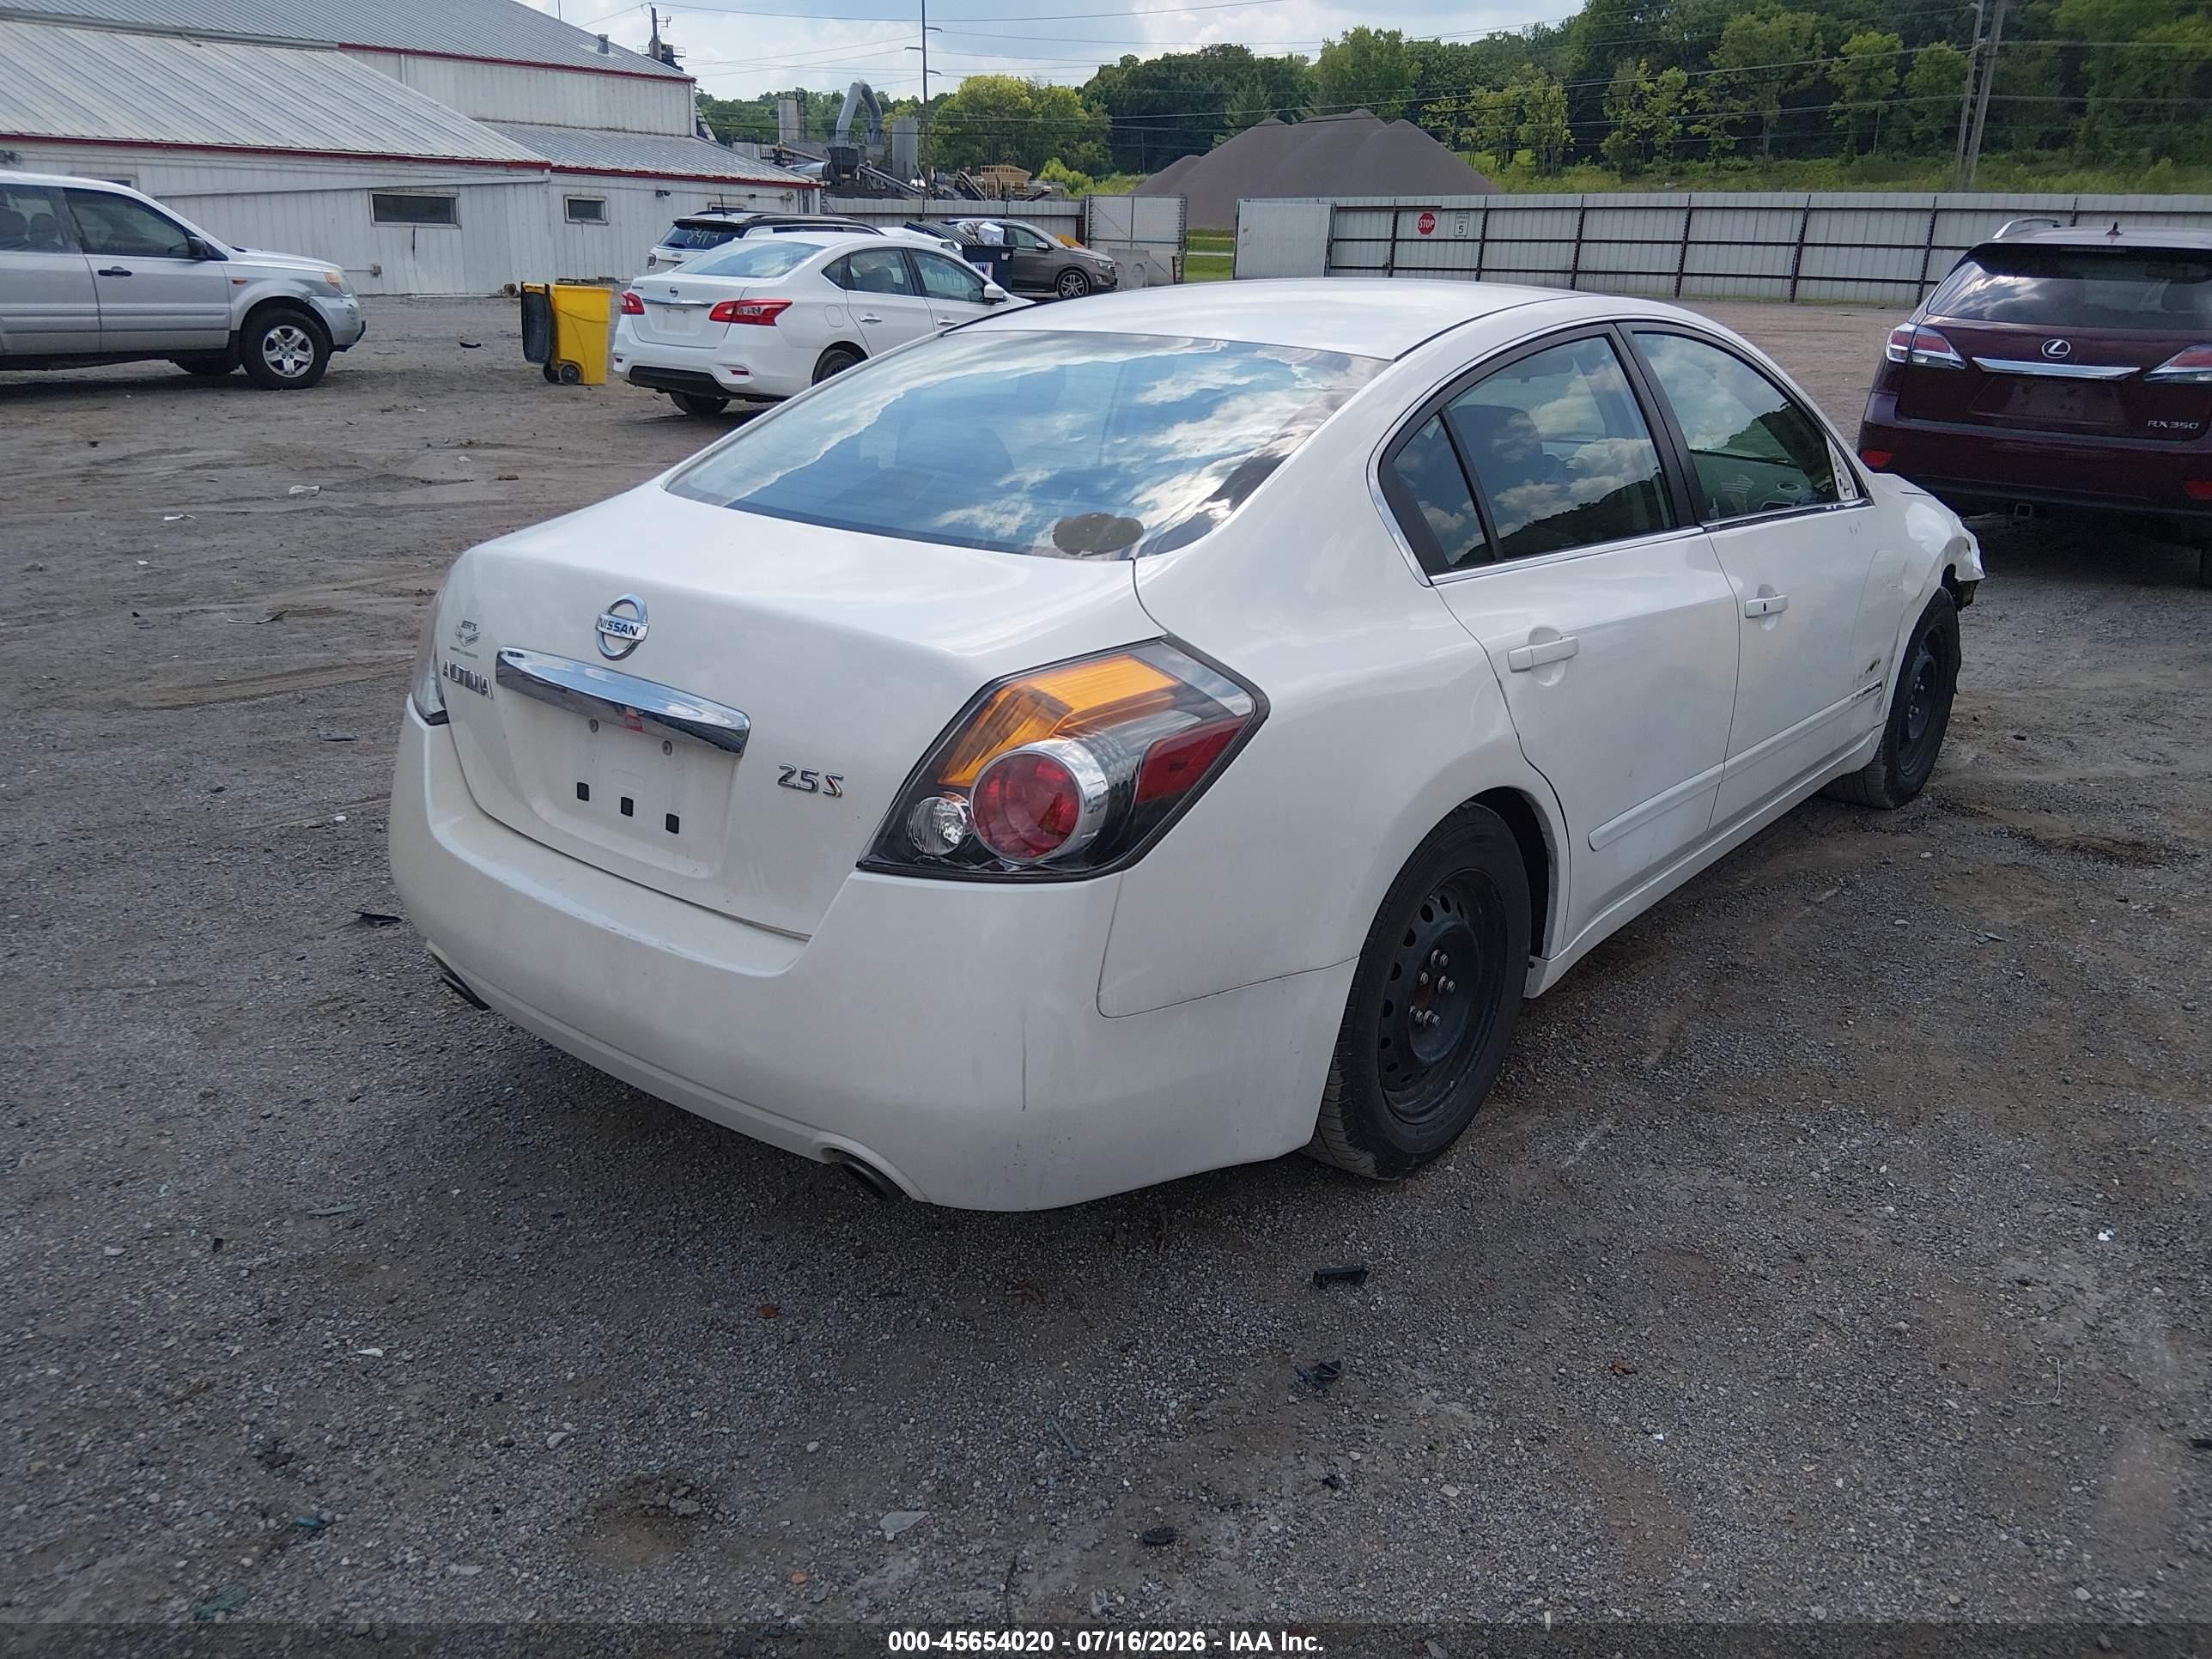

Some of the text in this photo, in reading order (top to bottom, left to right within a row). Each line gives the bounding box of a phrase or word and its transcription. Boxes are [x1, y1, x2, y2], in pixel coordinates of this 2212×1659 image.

[1419, 219, 1435, 228] STOP
[1458, 225, 1464, 234] 5
[598, 617, 639, 636] NISSAN
